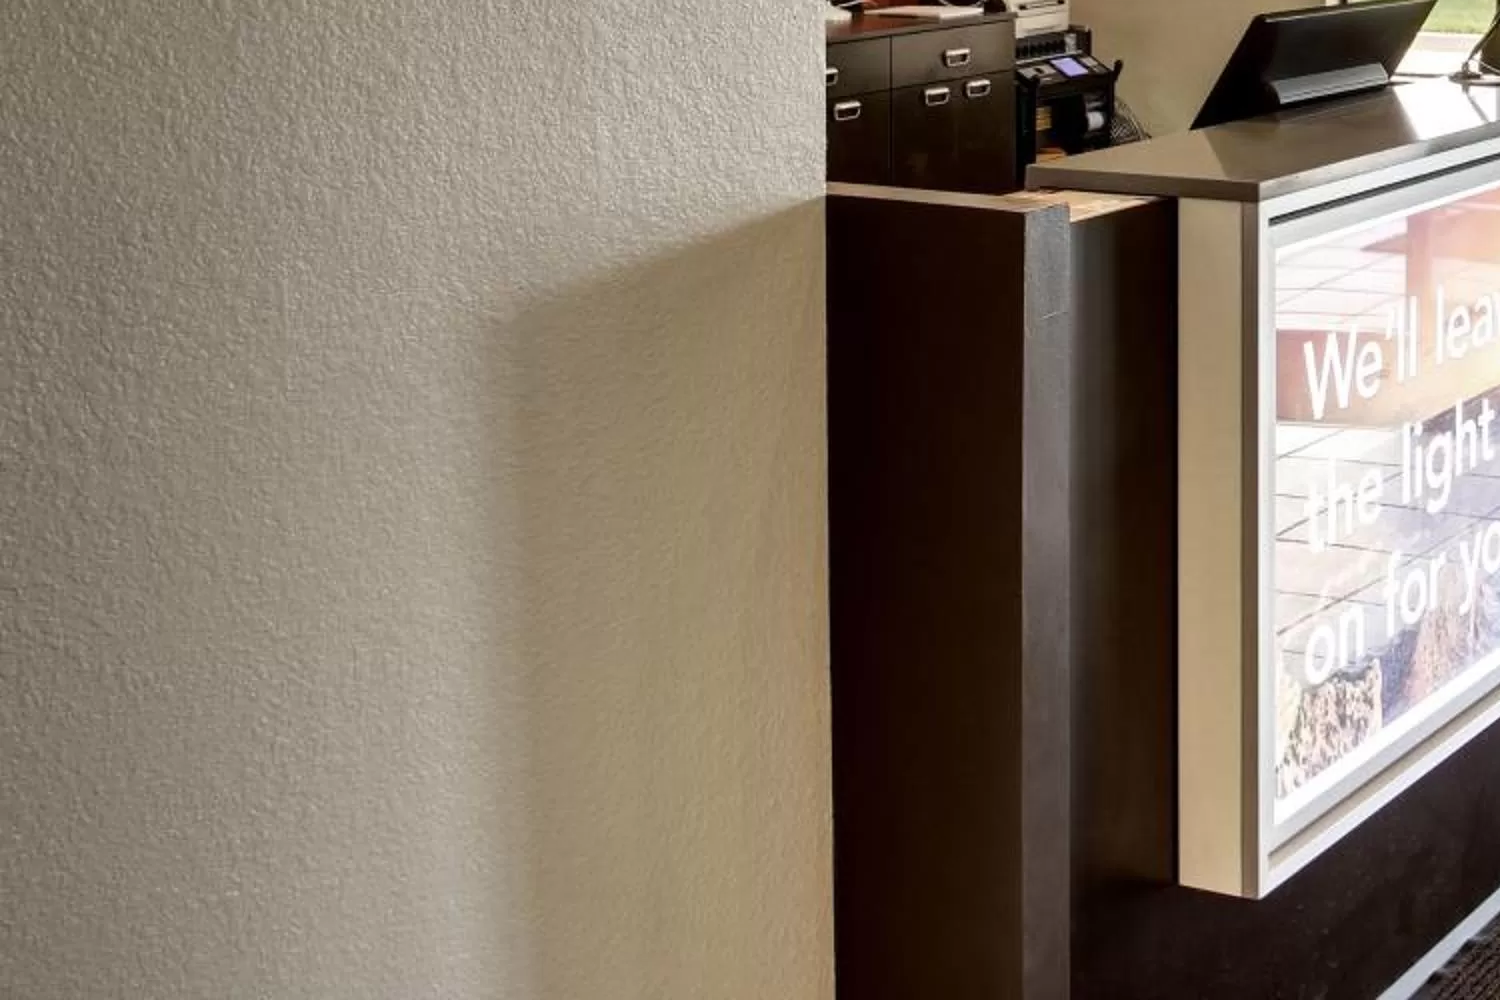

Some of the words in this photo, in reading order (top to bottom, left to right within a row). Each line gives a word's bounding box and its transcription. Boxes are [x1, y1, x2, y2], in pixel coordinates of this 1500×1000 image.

[1303, 295, 1418, 421] We'll
[1304, 455, 1383, 552] the
[1401, 398, 1495, 514] light
[1304, 604, 1364, 685] on
[1384, 549, 1446, 638] for
